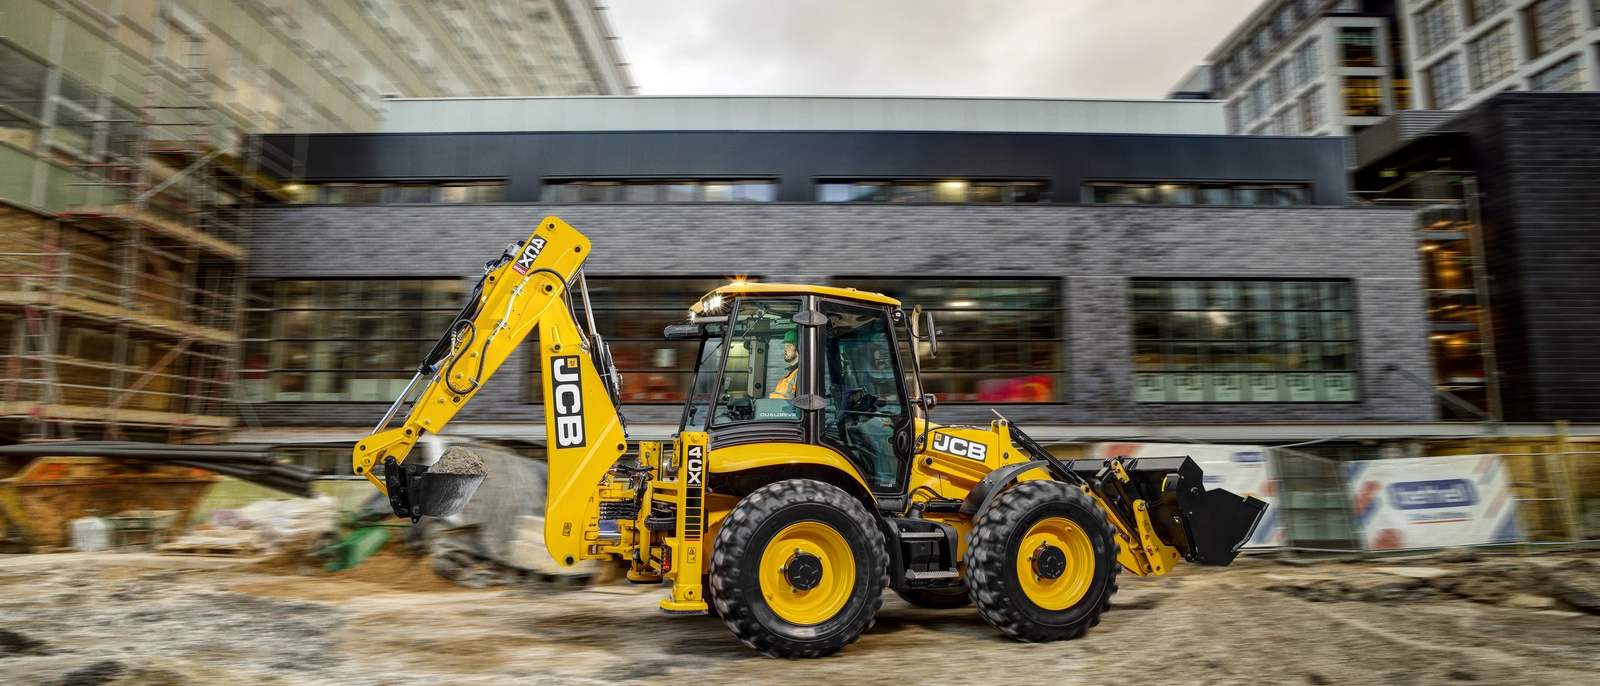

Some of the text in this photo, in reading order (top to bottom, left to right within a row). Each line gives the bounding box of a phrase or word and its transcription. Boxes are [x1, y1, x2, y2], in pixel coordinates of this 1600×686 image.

[518, 238, 545, 269] 4CX
[553, 358, 583, 447] JCB
[687, 446, 702, 484] 4CX
[934, 435, 986, 461] JCB
